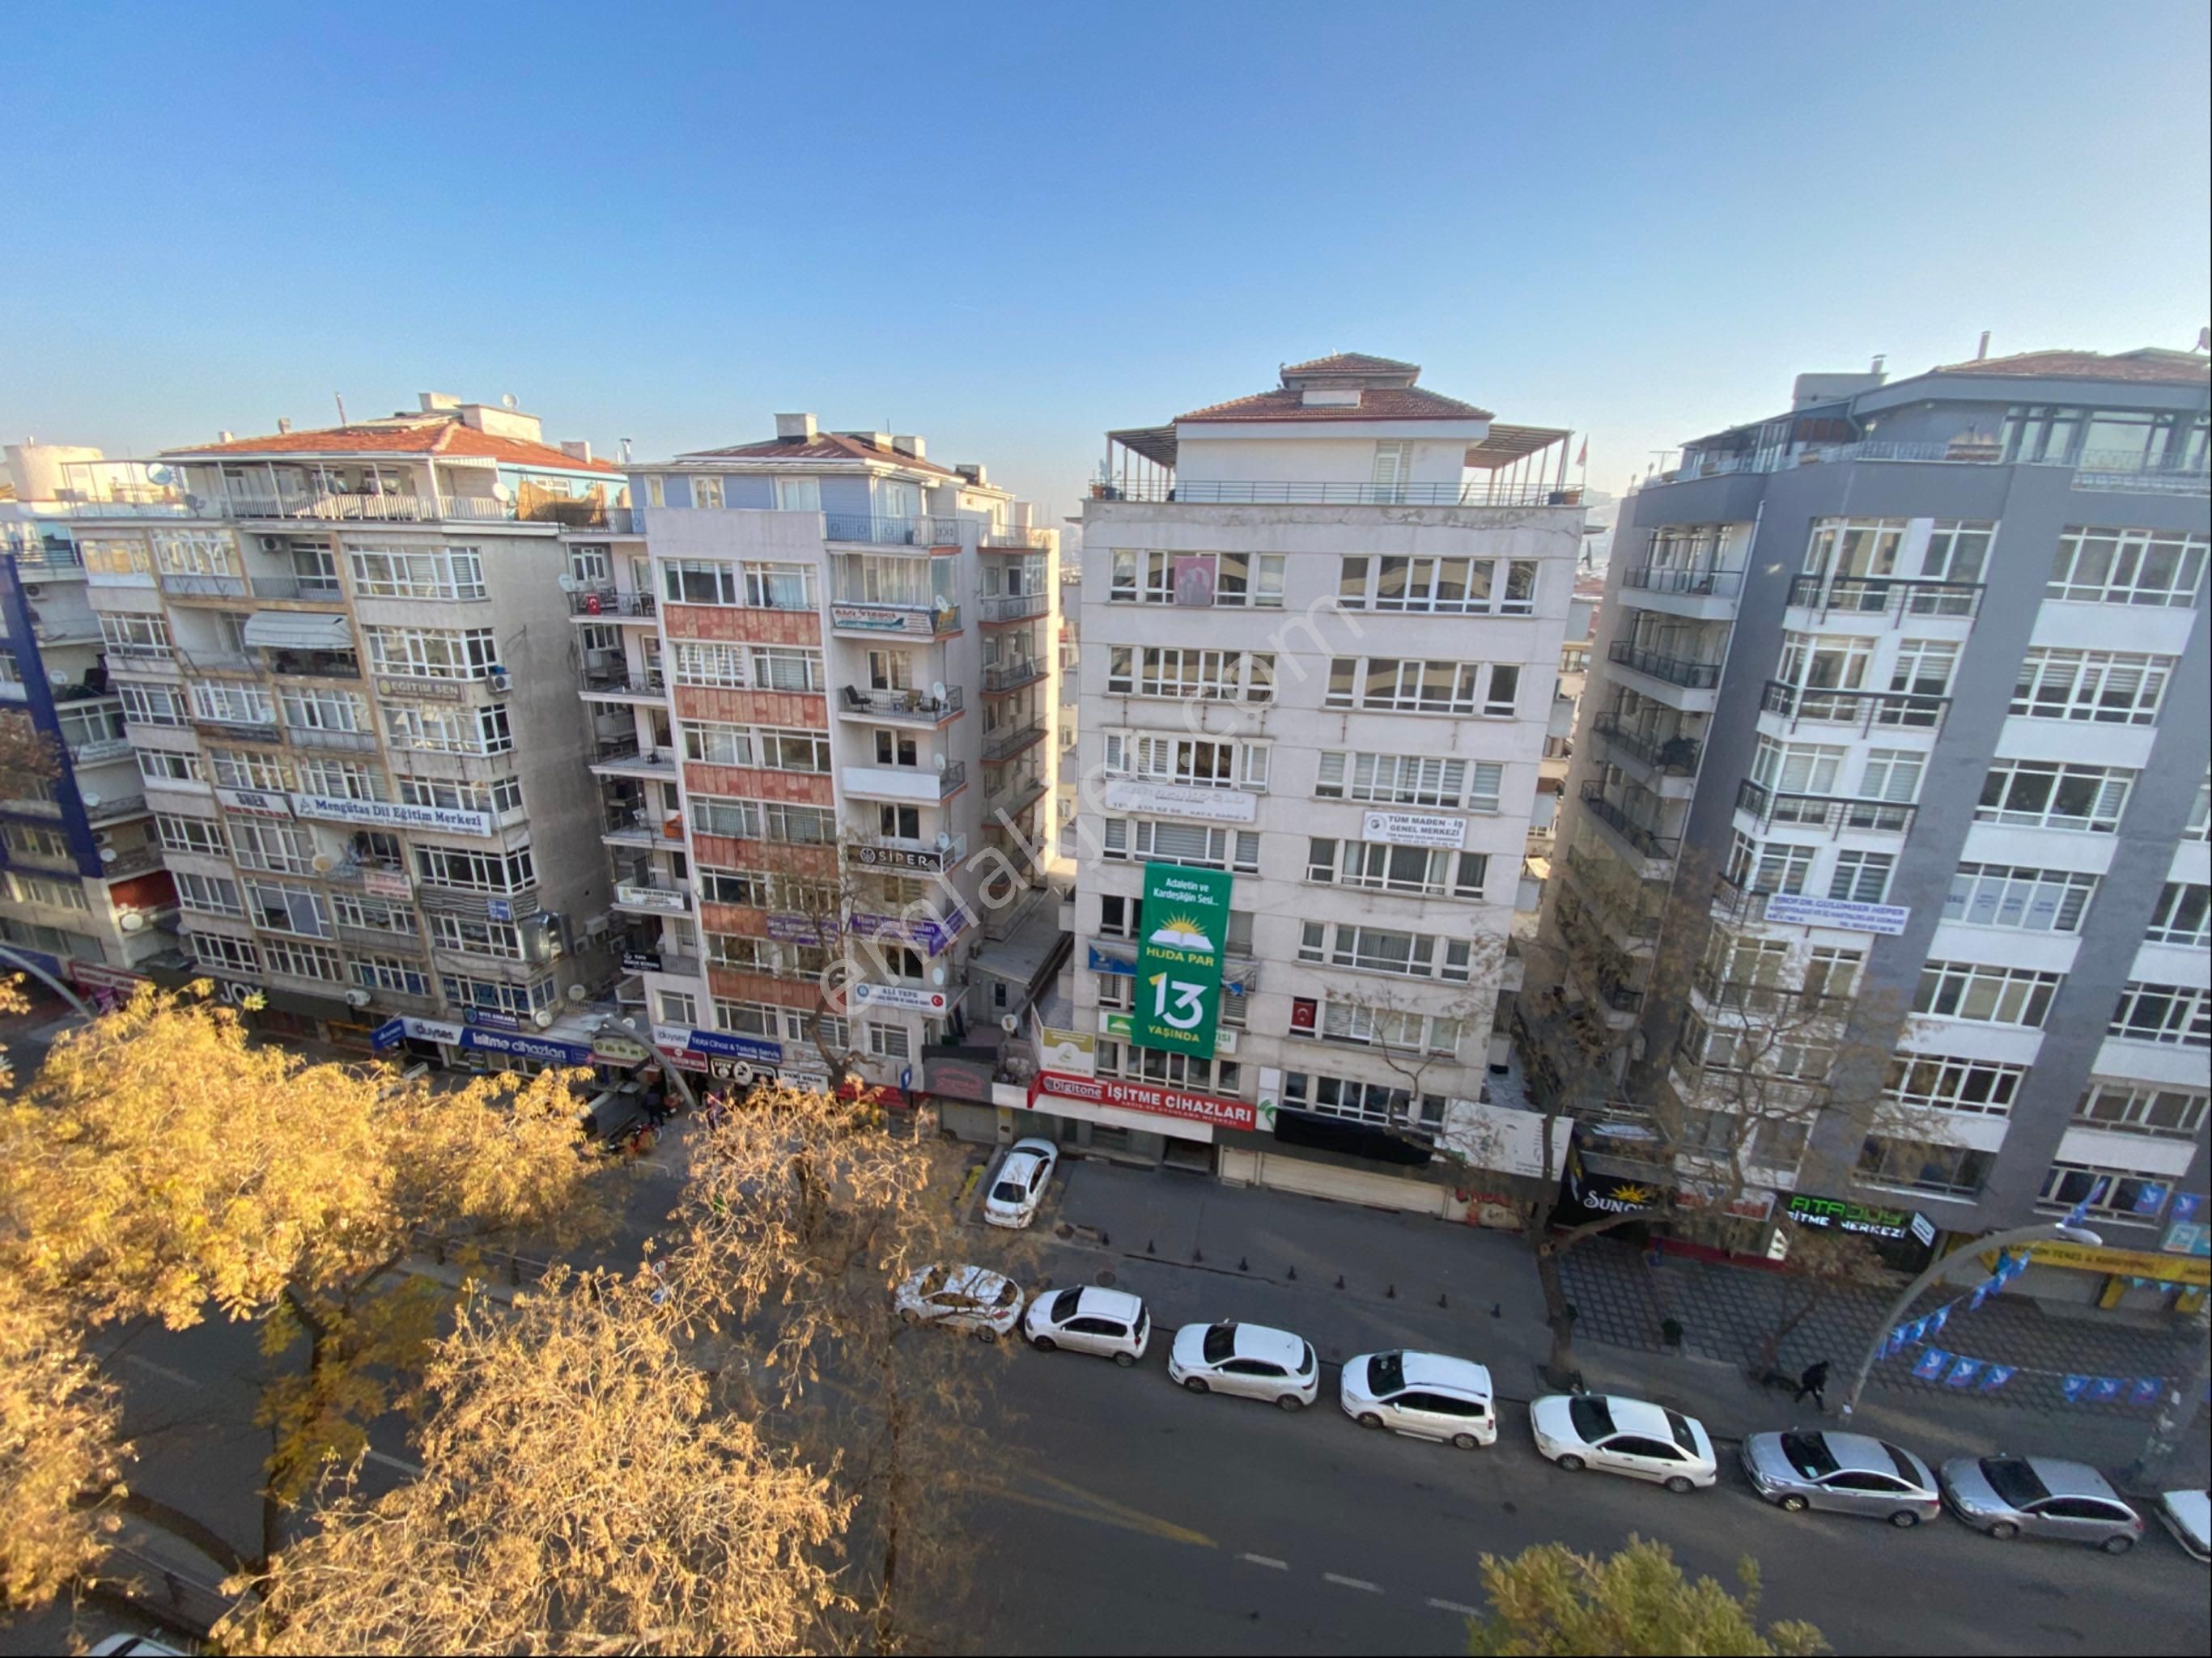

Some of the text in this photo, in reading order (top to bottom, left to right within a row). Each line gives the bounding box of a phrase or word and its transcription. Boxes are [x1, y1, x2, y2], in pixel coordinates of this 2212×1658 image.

[435, 685, 459, 695] SEN
[373, 805, 391, 817] Dil
[393, 808, 432, 821] Eğitim
[435, 812, 482, 826] Merkezi
[1387, 815, 1409, 824] TÜM
[1411, 816, 1446, 826] MADEN
[1390, 825, 1460, 837] GENEL MERKEZİ
[1165, 877, 1209, 893] Adaletin ve
[1153, 887, 1196, 902] Kardeşliğin
[1188, 953, 1215, 967] PAR
[1148, 971, 1208, 1029] 13
[1148, 1024, 1199, 1043] YAŞINDA
[1052, 1080, 1252, 1122] Digitone İŞİTME CİHAZLARI
